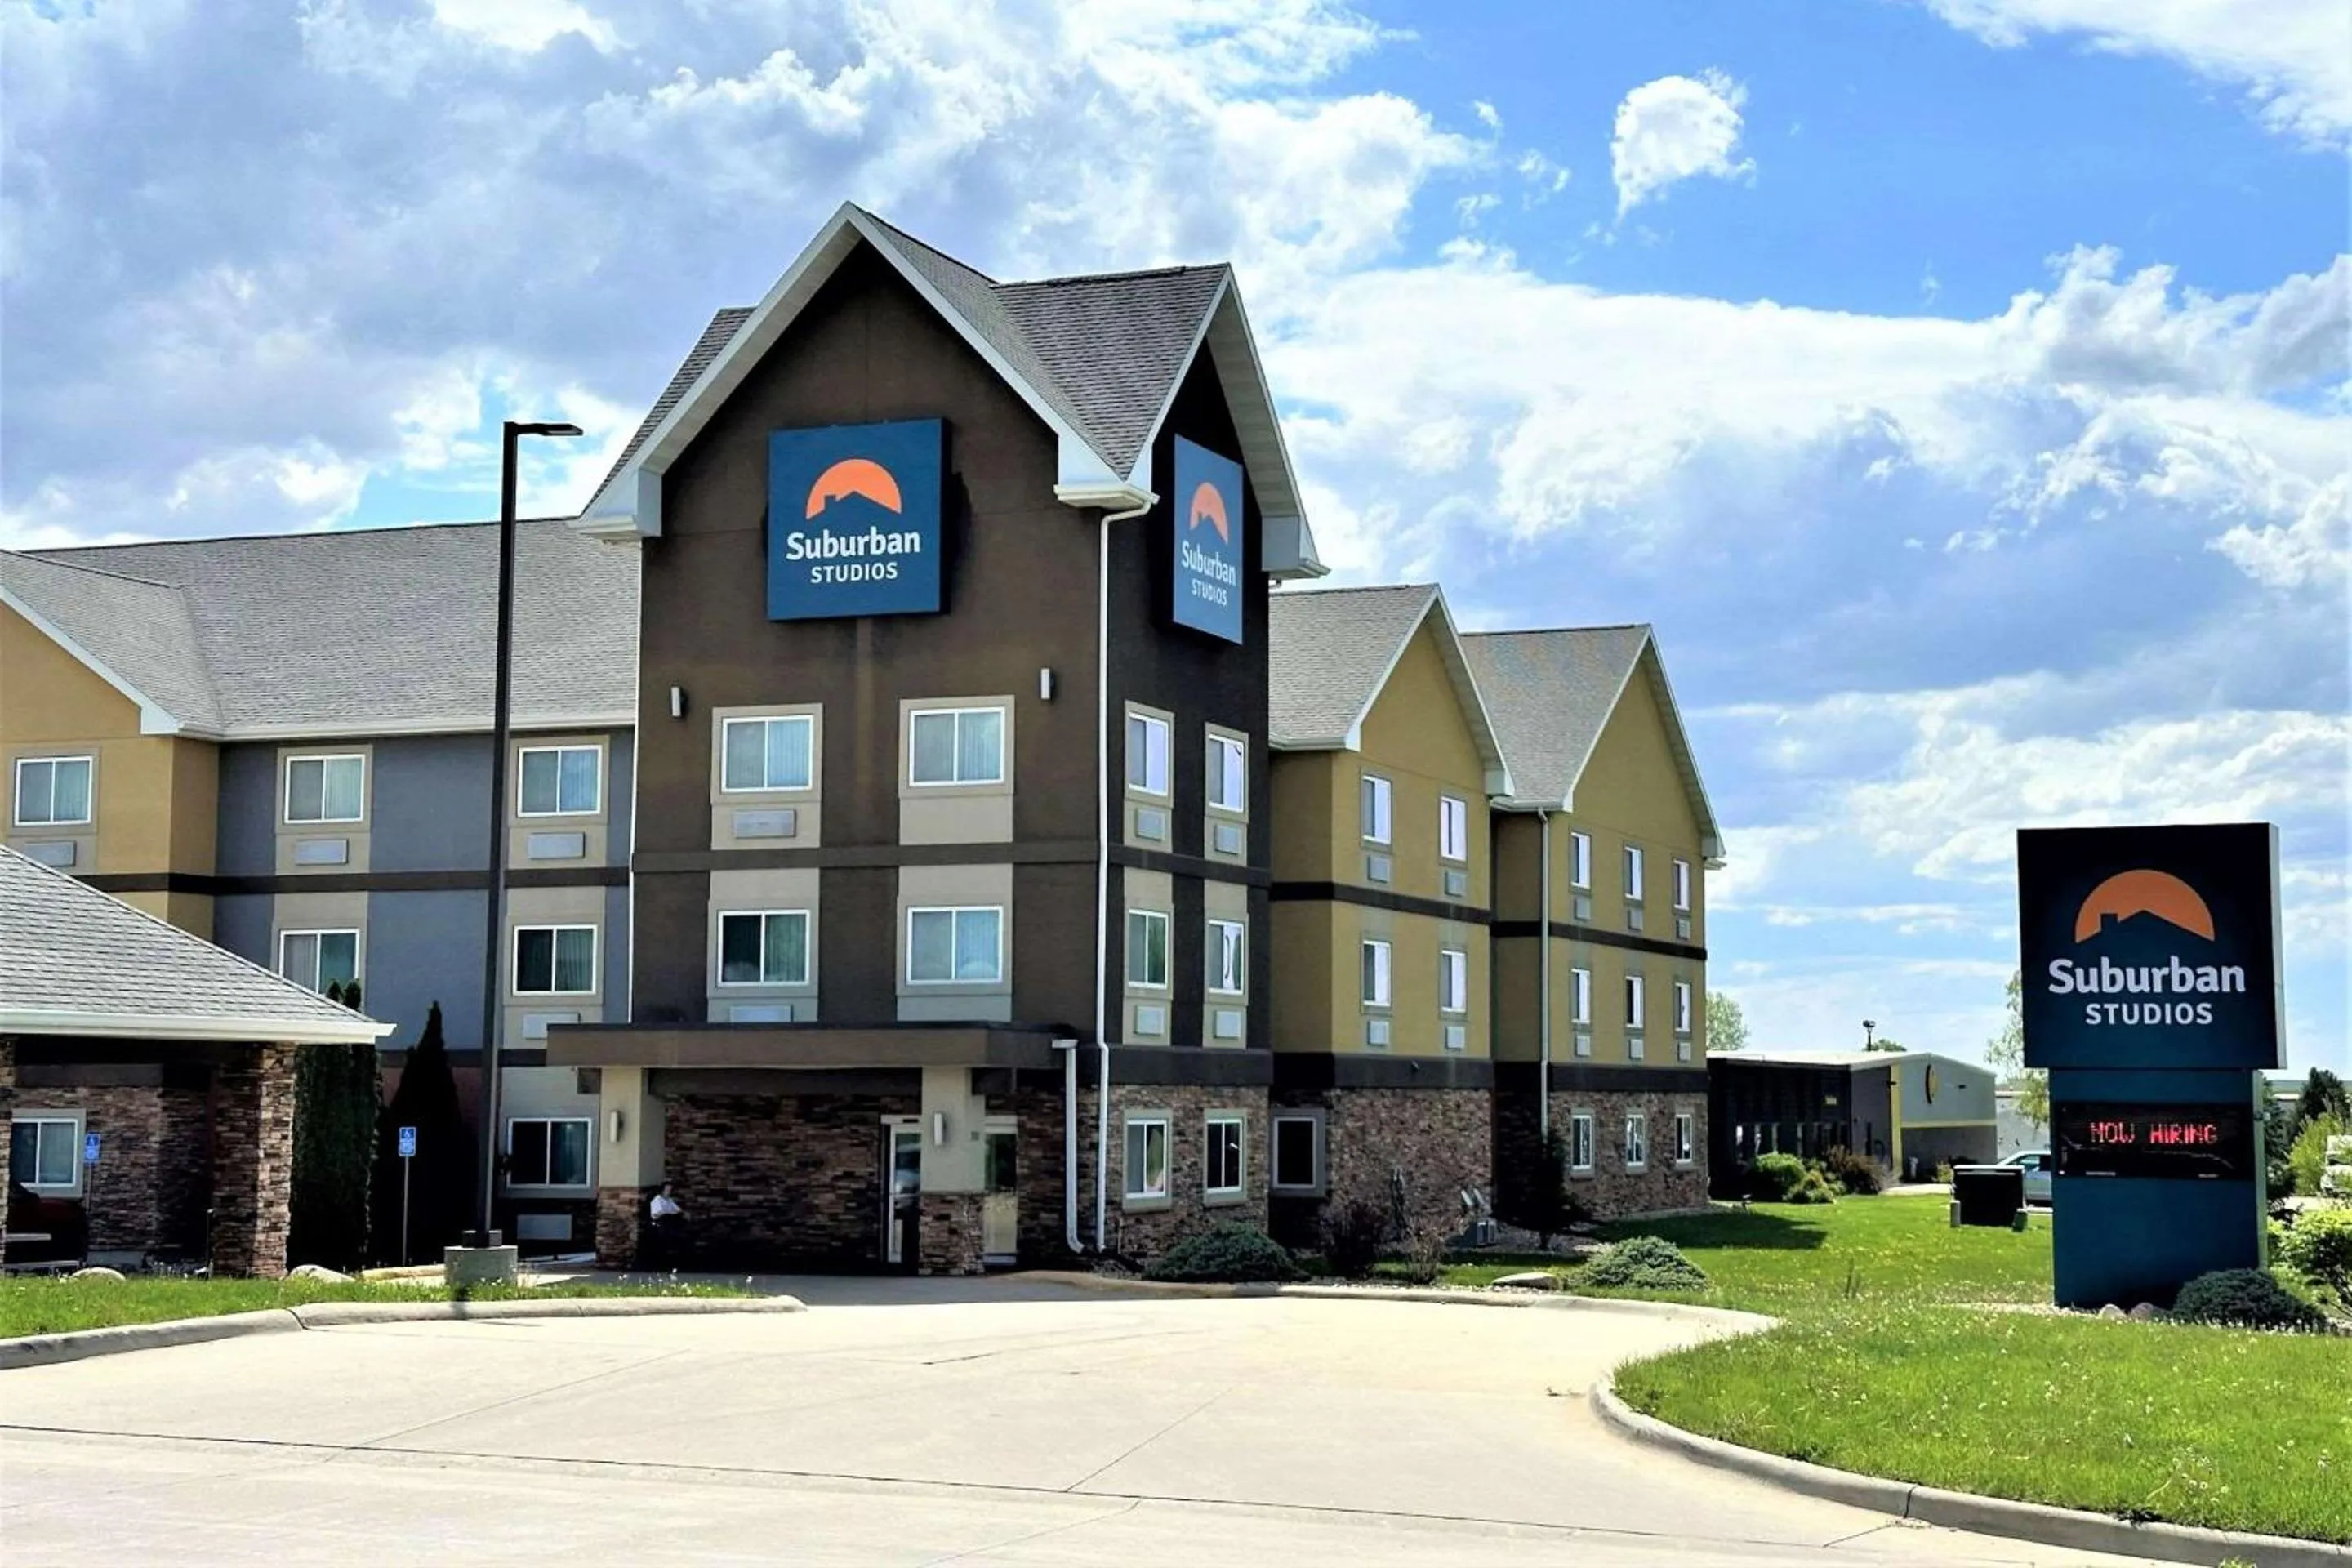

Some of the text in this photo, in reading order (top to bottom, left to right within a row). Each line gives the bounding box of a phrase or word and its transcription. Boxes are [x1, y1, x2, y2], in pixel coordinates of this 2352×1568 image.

[786, 526, 920, 560] Suburban
[811, 562, 898, 583] STUDIOS
[1181, 539, 1236, 586] Suburban
[1191, 578, 1227, 606] STUDIOS
[2048, 956, 2246, 994] Suburban
[2085, 1002, 2213, 1025] STUDIOS
[2090, 1121, 2219, 1144] NOW HIRING
